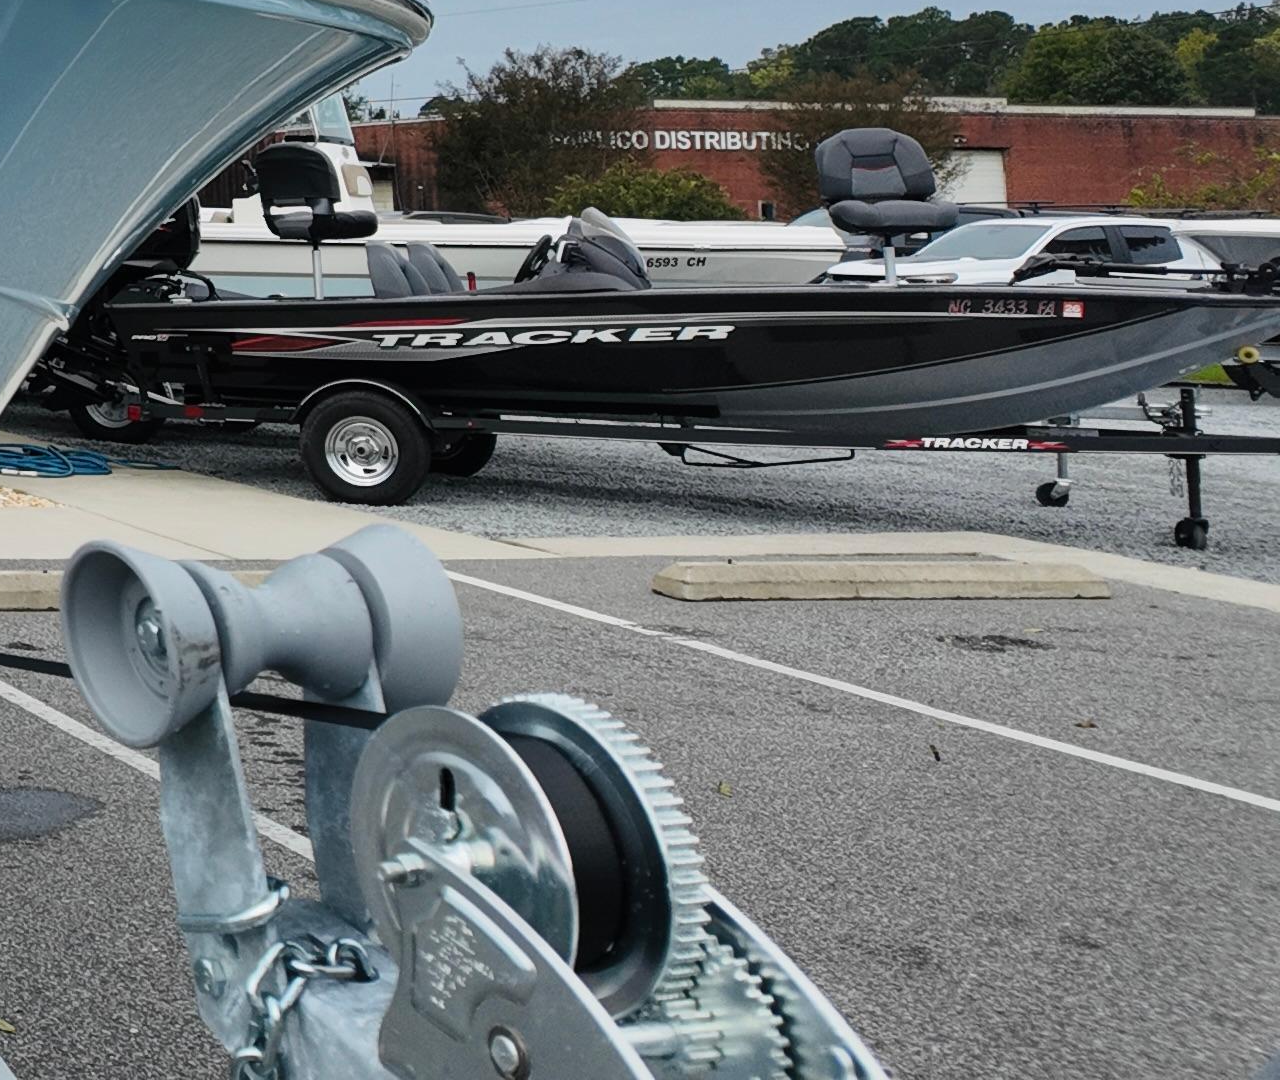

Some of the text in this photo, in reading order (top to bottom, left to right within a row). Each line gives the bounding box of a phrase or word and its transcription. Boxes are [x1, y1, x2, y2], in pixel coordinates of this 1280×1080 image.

[646, 256, 707, 268] 6593 CH
[948, 299, 972, 314] NC
[981, 299, 1028, 315] 3433
[372, 325, 736, 348] TRACKER
[920, 437, 1029, 450] TRACKER
